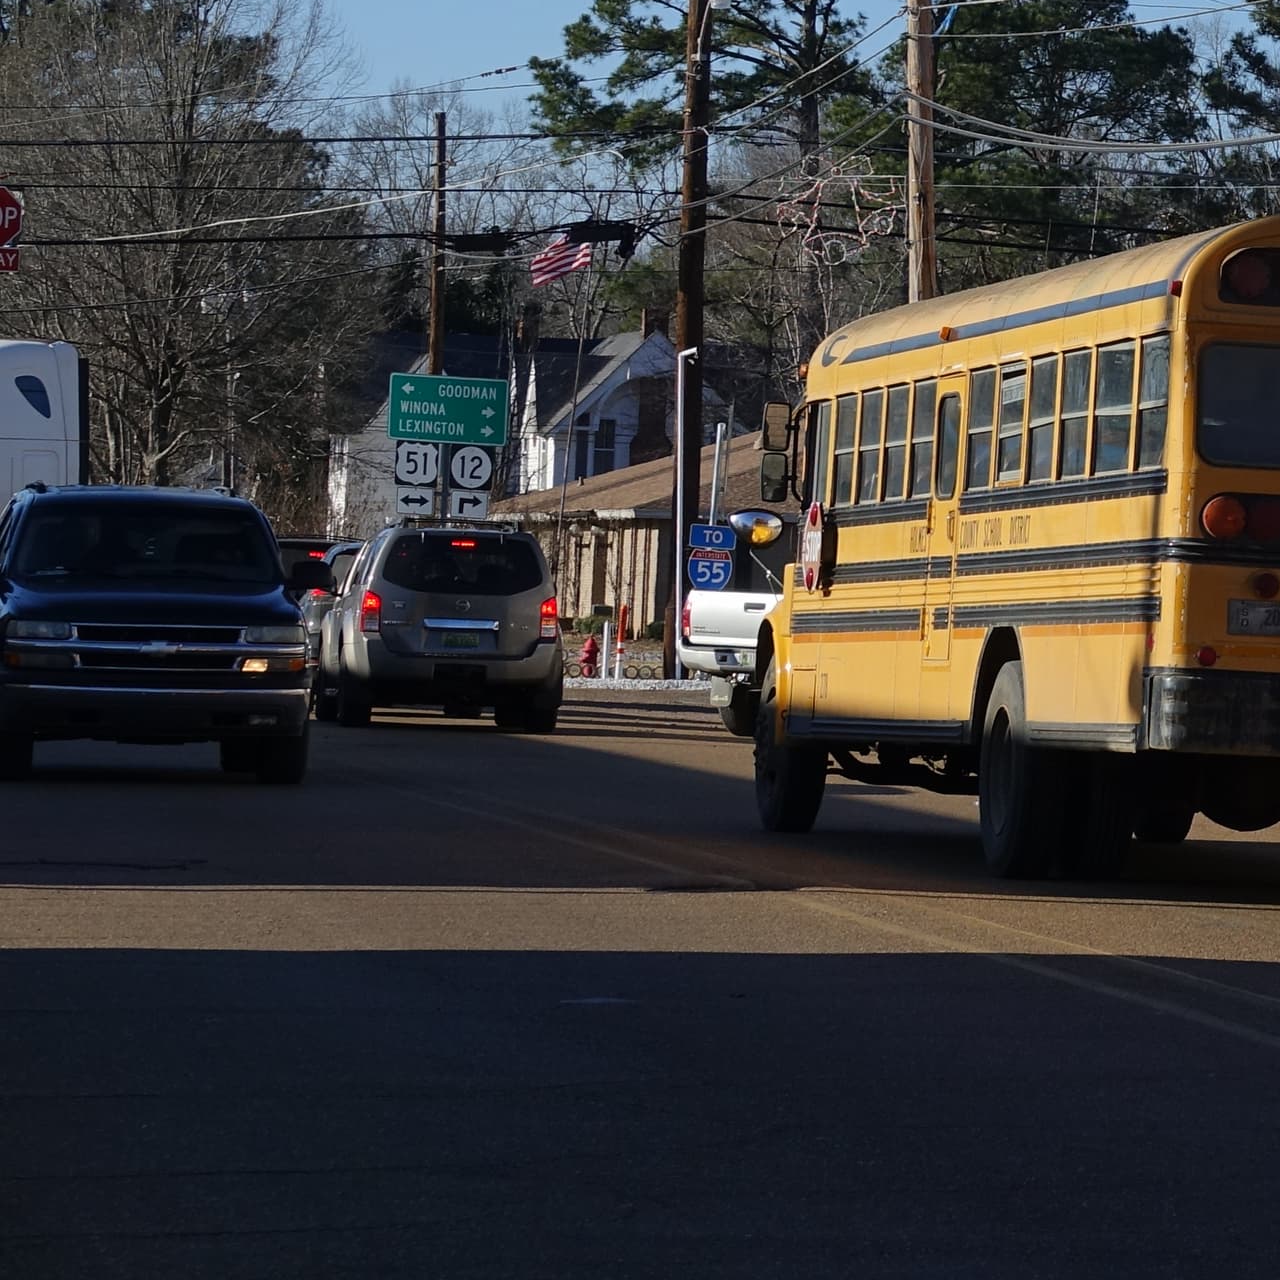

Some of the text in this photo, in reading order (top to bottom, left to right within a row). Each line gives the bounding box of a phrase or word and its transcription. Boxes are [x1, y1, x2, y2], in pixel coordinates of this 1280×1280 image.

[438, 384, 497, 400] GOODMAN
[400, 400, 446, 416] WINONA
[399, 419, 464, 436] LEXINGTON
[405, 450, 429, 476] 51
[459, 455, 483, 480] 12
[703, 530, 723, 544] TO
[960, 520, 979, 549] COUNTY
[983, 517, 1002, 547] SCHOOL
[1009, 514, 1031, 545] DISTRICT
[696, 561, 725, 583] 55
